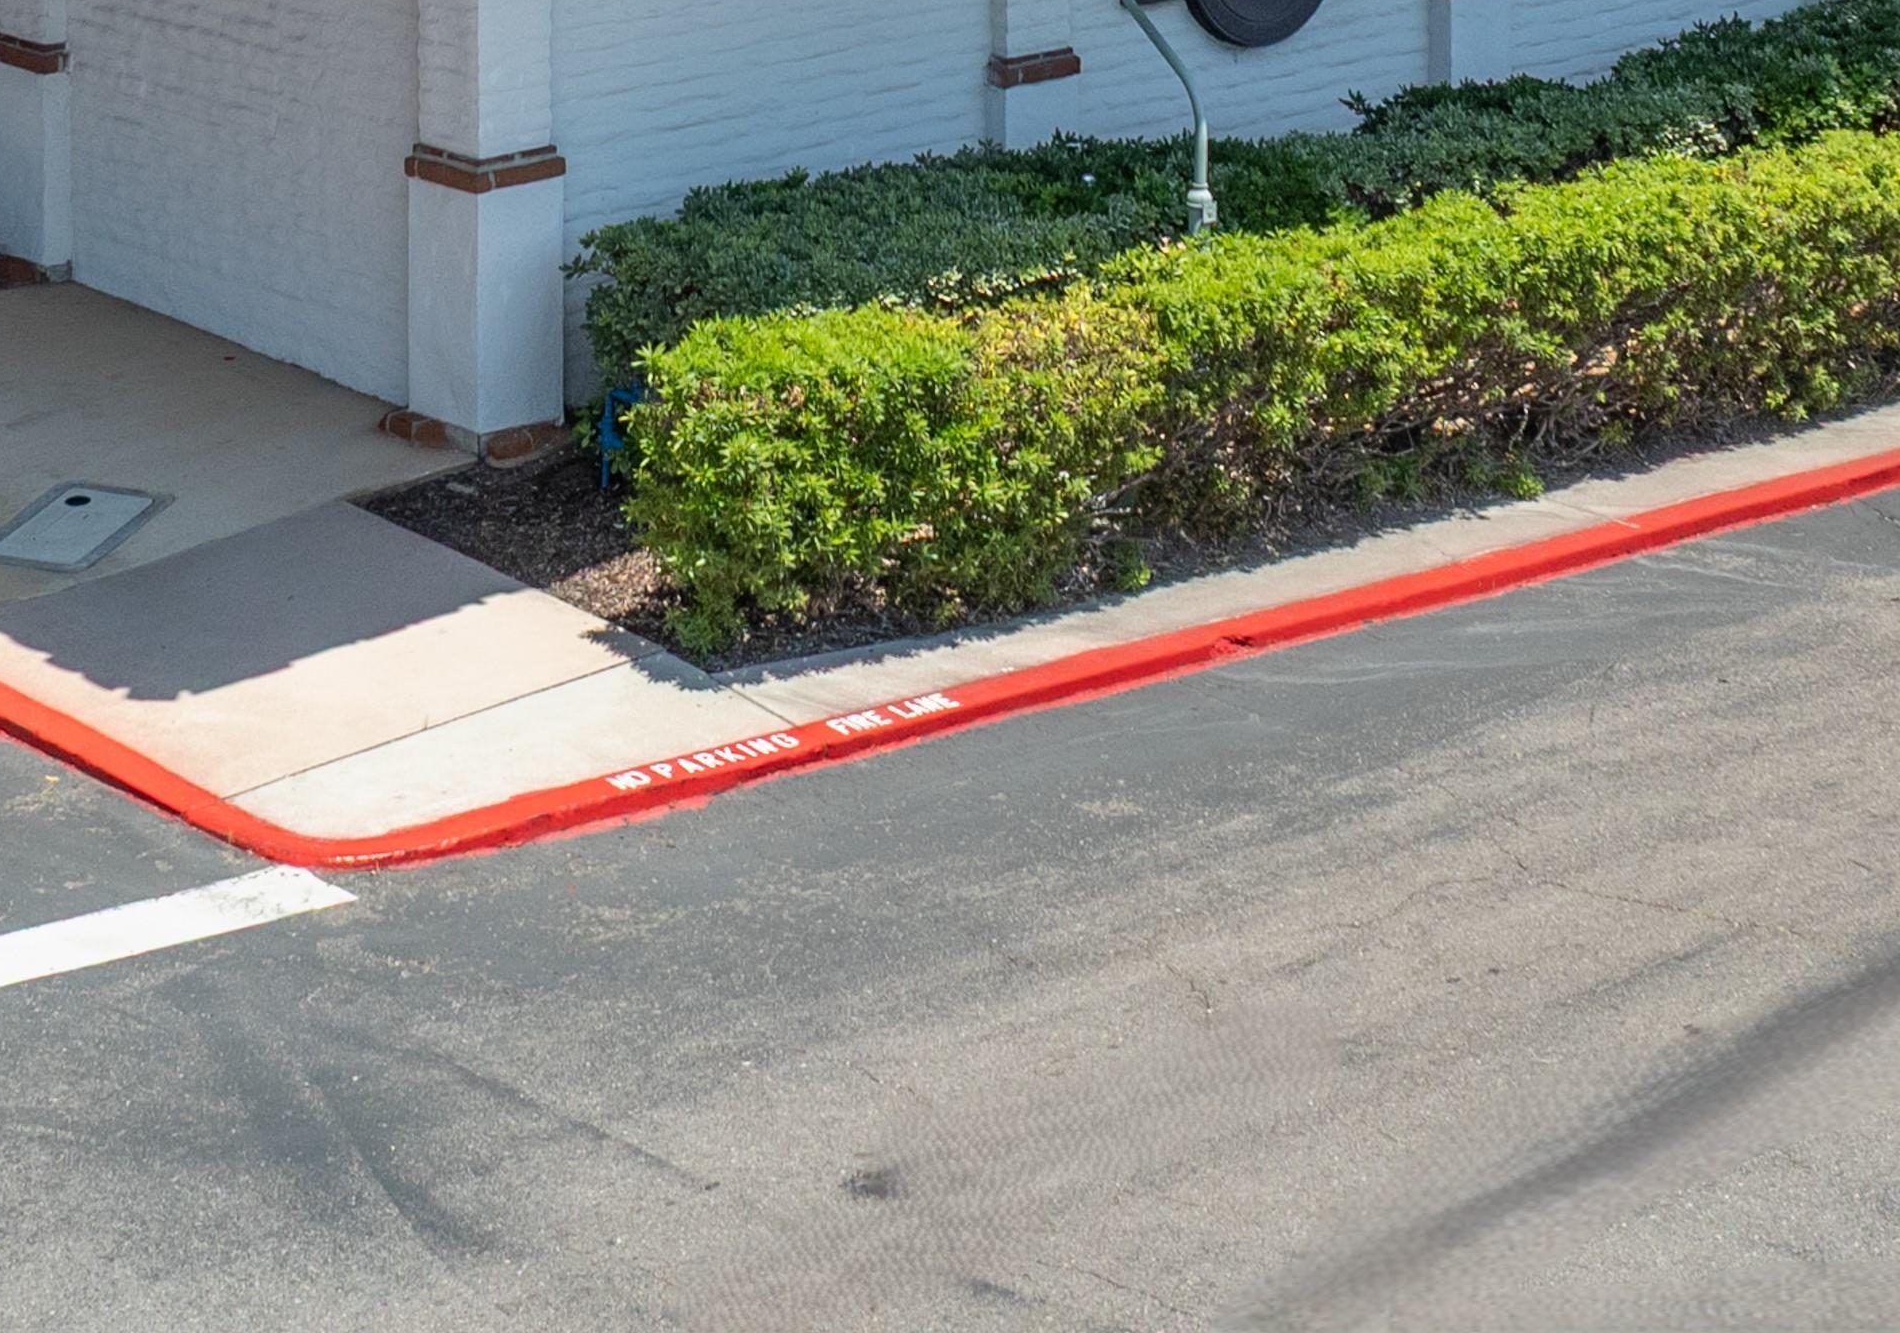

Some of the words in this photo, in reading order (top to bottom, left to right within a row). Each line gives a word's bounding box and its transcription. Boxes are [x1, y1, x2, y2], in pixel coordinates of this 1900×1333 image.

[605, 769, 652, 791] NO
[651, 732, 800, 779] PARKING
[825, 709, 892, 737] FIRE
[887, 692, 960, 720] LANE
